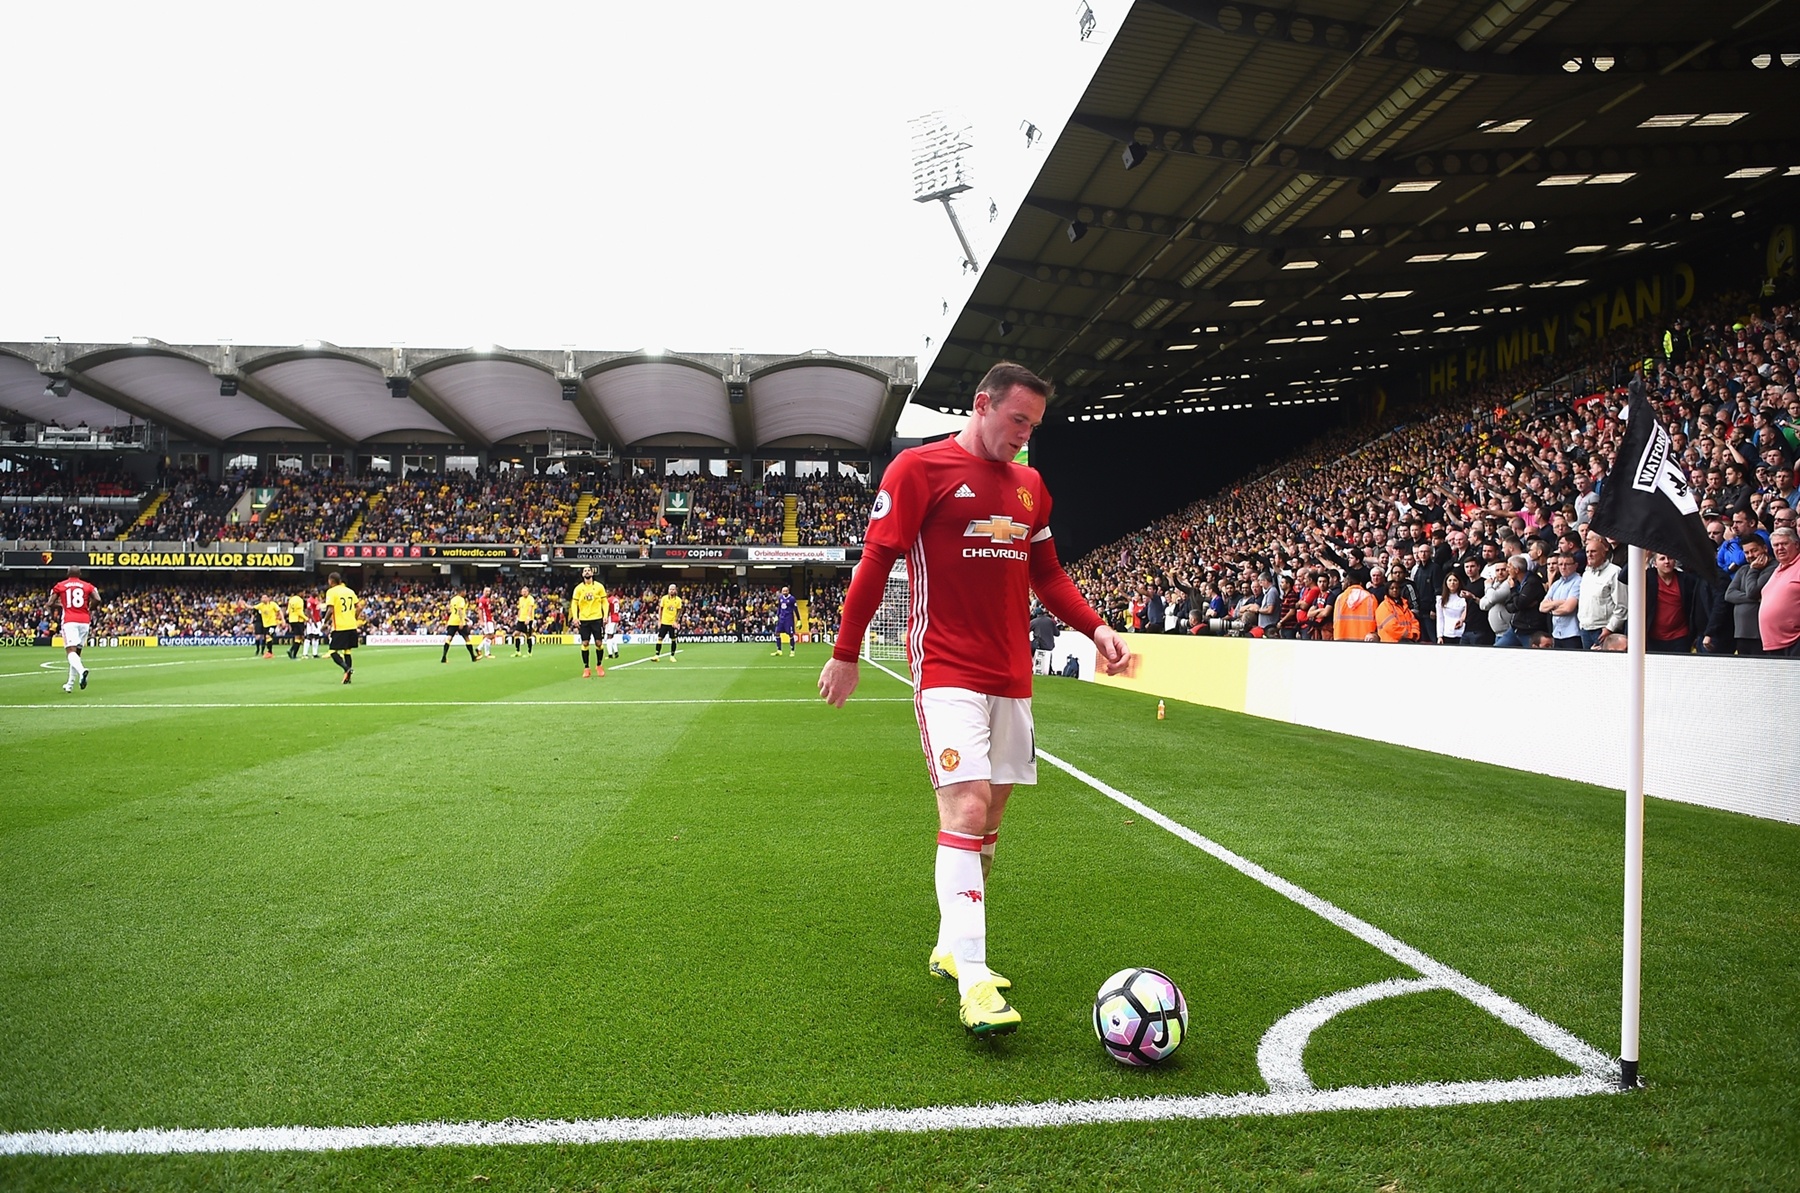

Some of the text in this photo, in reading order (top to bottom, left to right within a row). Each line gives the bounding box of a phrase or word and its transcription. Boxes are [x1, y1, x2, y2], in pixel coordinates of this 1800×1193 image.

[1465, 314, 1559, 382] FAMILY
[1574, 261, 1696, 338] STAND
[1639, 429, 1667, 483] WATFORD
[442, 548, 507, 557] watfordfc.com
[577, 547, 627, 555] BROCKET HALL
[665, 547, 723, 559] easycopiers
[754, 549, 825, 557] Orbitalfasteners.co.uk
[962, 548, 1028, 562] CHEVROLET
[88, 553, 295, 566] THE GRAHAM TAYLOR STAND
[65, 588, 84, 608] 18
[340, 597, 353, 612] 37
[160, 636, 256, 646] eurotechservices.co.u
